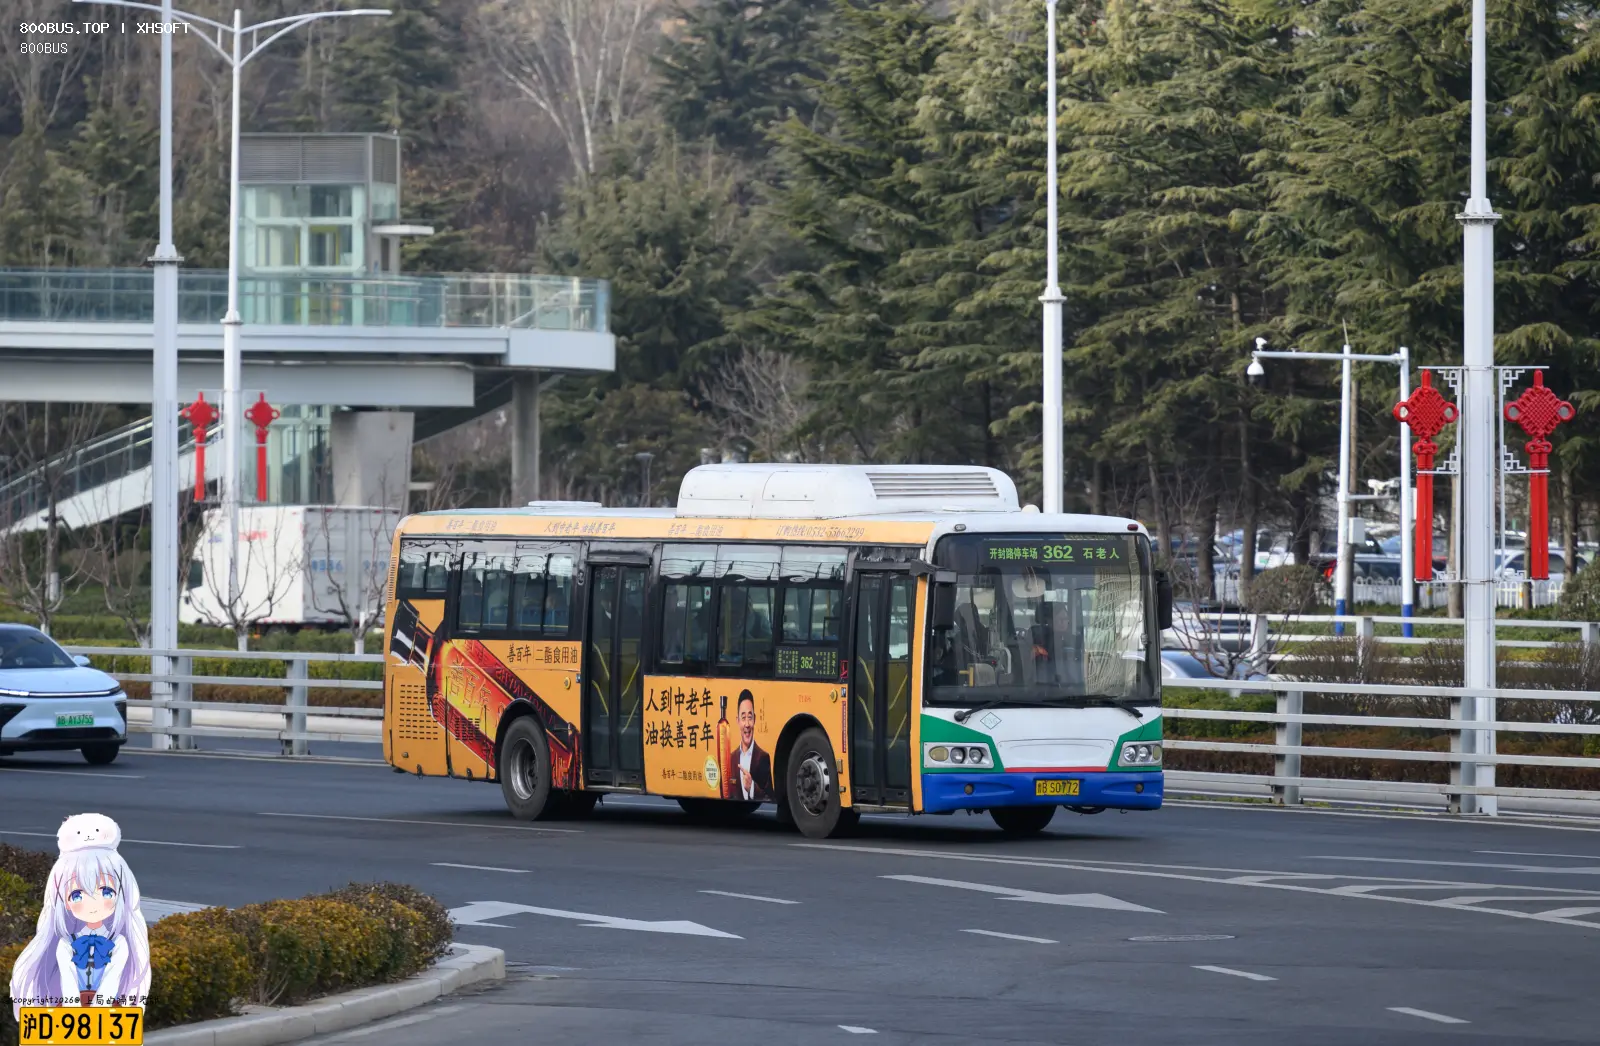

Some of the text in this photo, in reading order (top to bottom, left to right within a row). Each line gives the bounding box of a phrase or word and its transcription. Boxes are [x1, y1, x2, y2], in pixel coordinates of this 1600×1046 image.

[989, 545, 1120, 560] 开封路停车场 362 石老人
[507, 643, 532, 664] 善百年
[800, 656, 814, 669] 362
[645, 686, 714, 718] 人到中老年
[645, 721, 714, 751] 油换善百年
